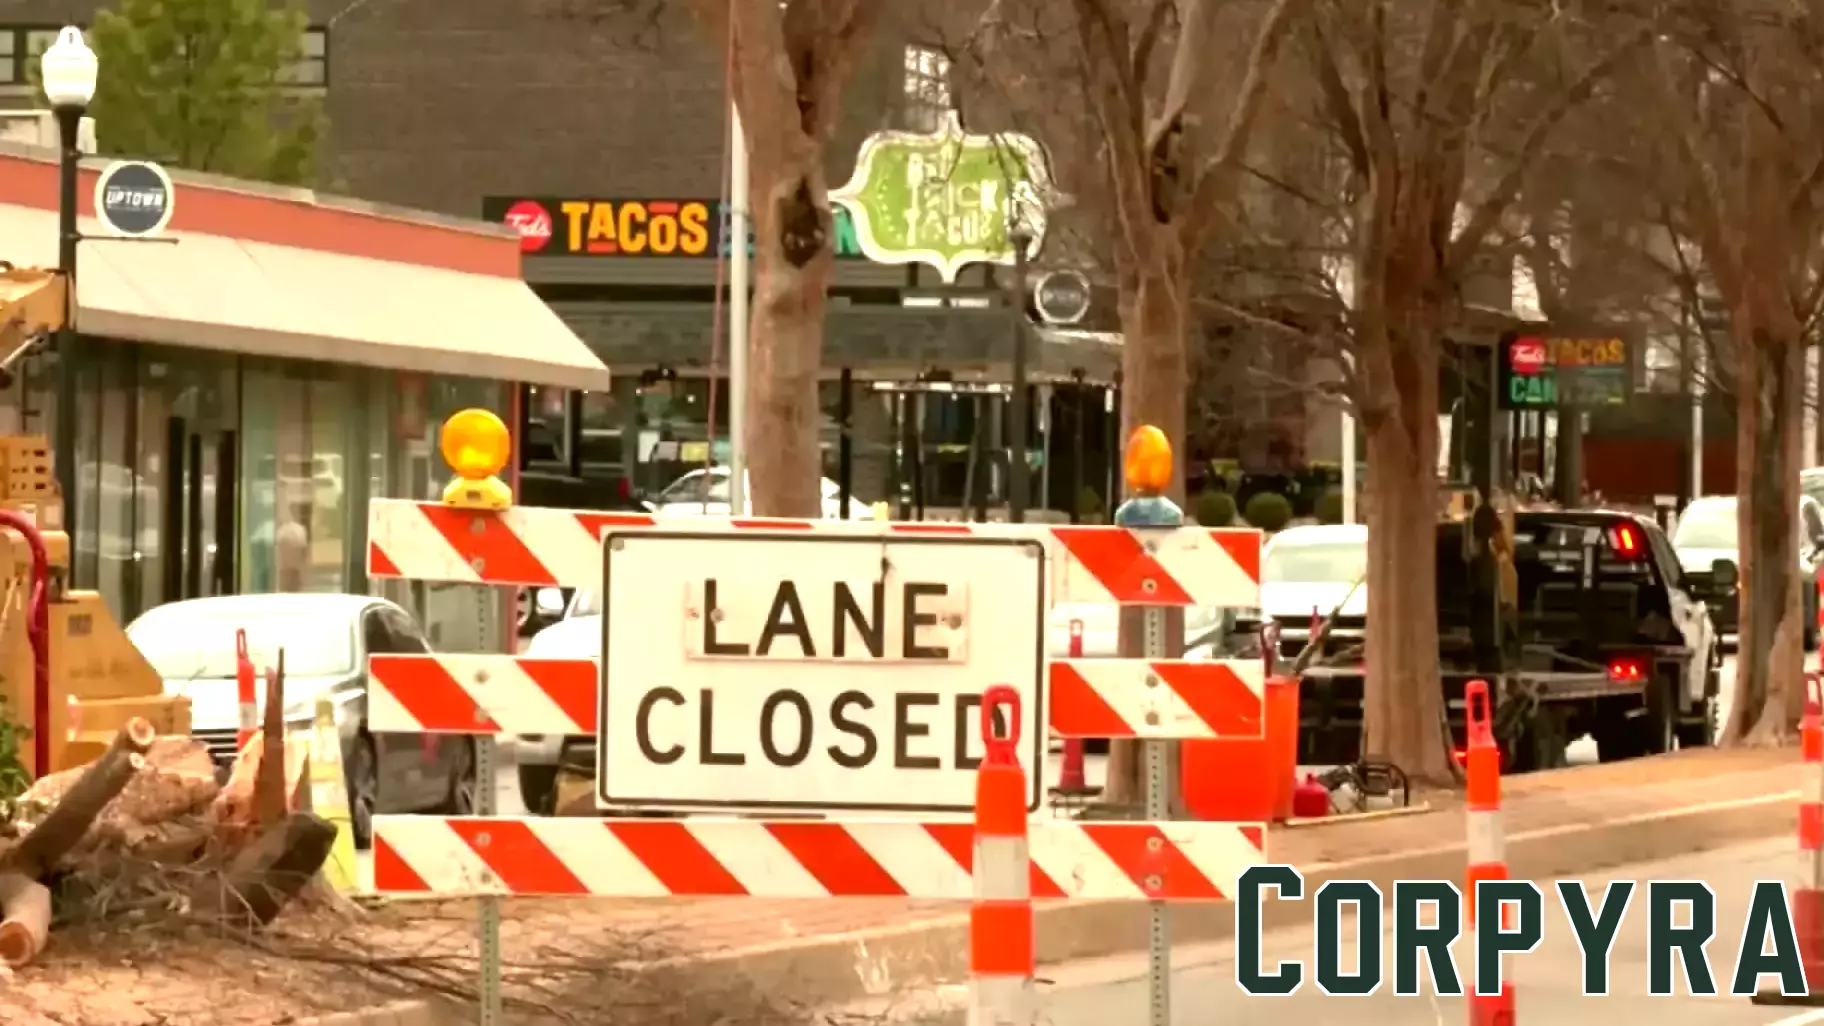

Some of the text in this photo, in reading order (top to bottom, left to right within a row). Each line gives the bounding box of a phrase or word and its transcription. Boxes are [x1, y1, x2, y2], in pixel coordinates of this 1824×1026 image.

[106, 190, 163, 207] UPTOWN
[561, 201, 708, 254] TACOS
[703, 578, 949, 658] LANE
[635, 685, 1008, 770] CLOSED
